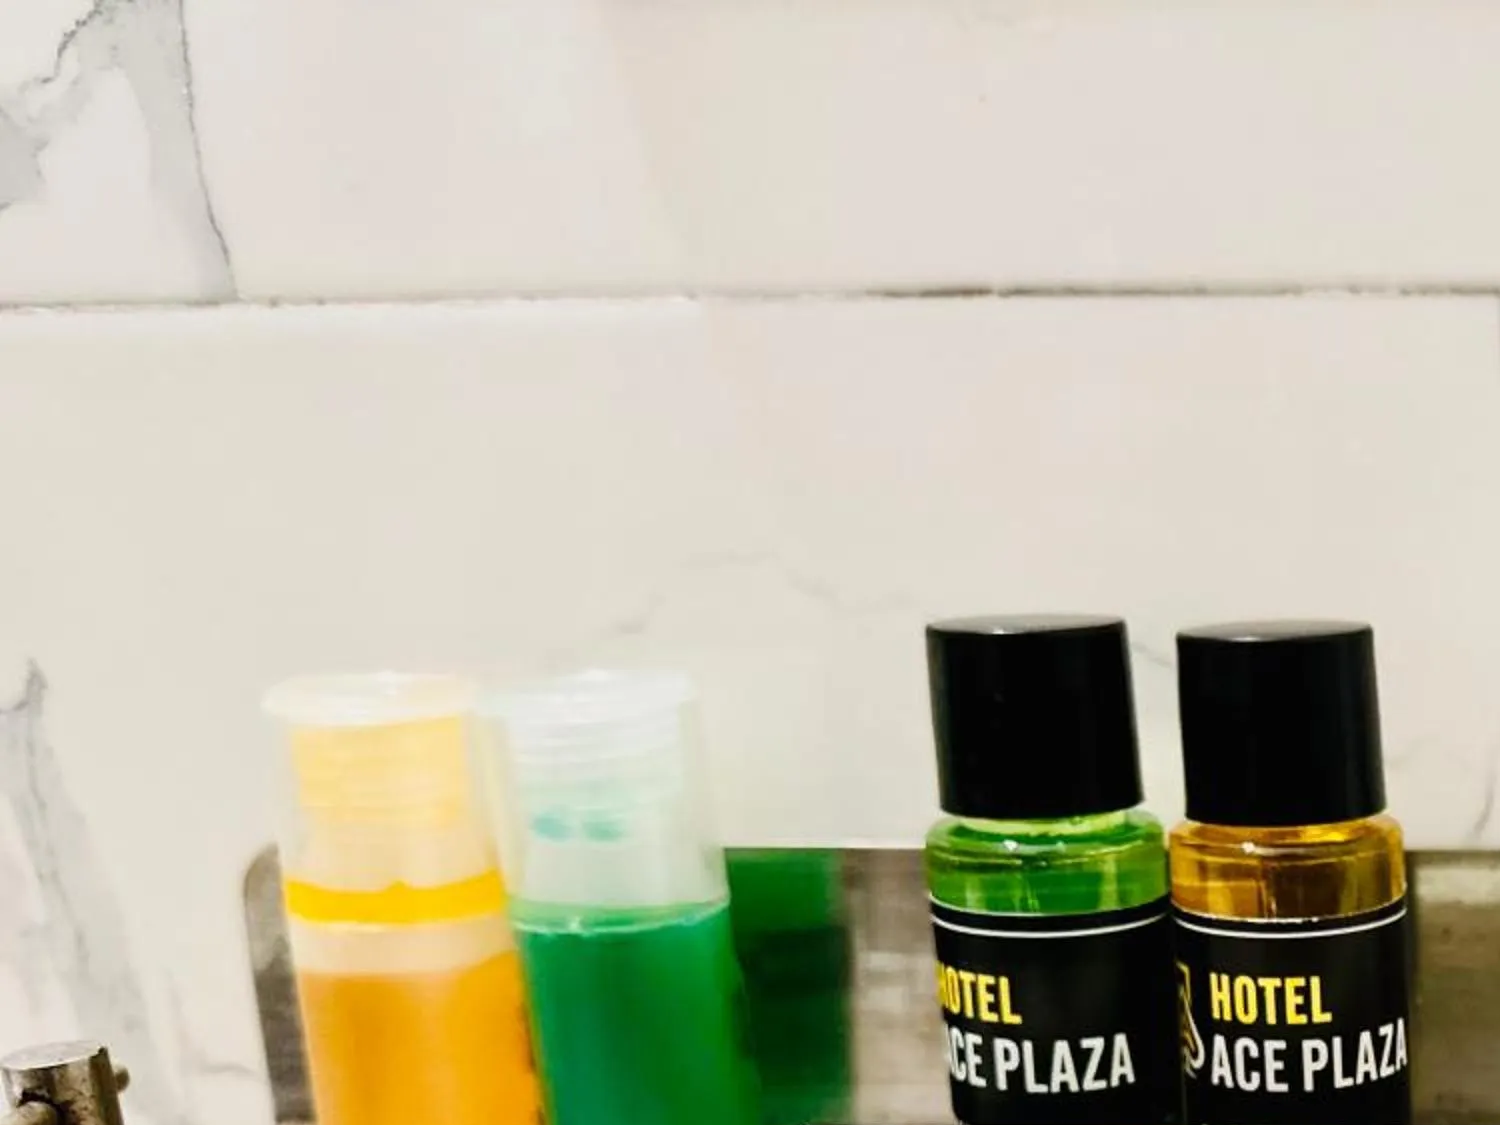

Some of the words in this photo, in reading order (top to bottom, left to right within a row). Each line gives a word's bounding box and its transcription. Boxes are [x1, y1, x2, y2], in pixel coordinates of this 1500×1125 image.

[1210, 971, 1332, 1025] HOTEL
[945, 1022, 987, 1088] CE
[993, 1033, 1136, 1094] PLAZA
[1210, 1034, 1289, 1093] ACE
[1301, 1017, 1408, 1093] PLAZA
